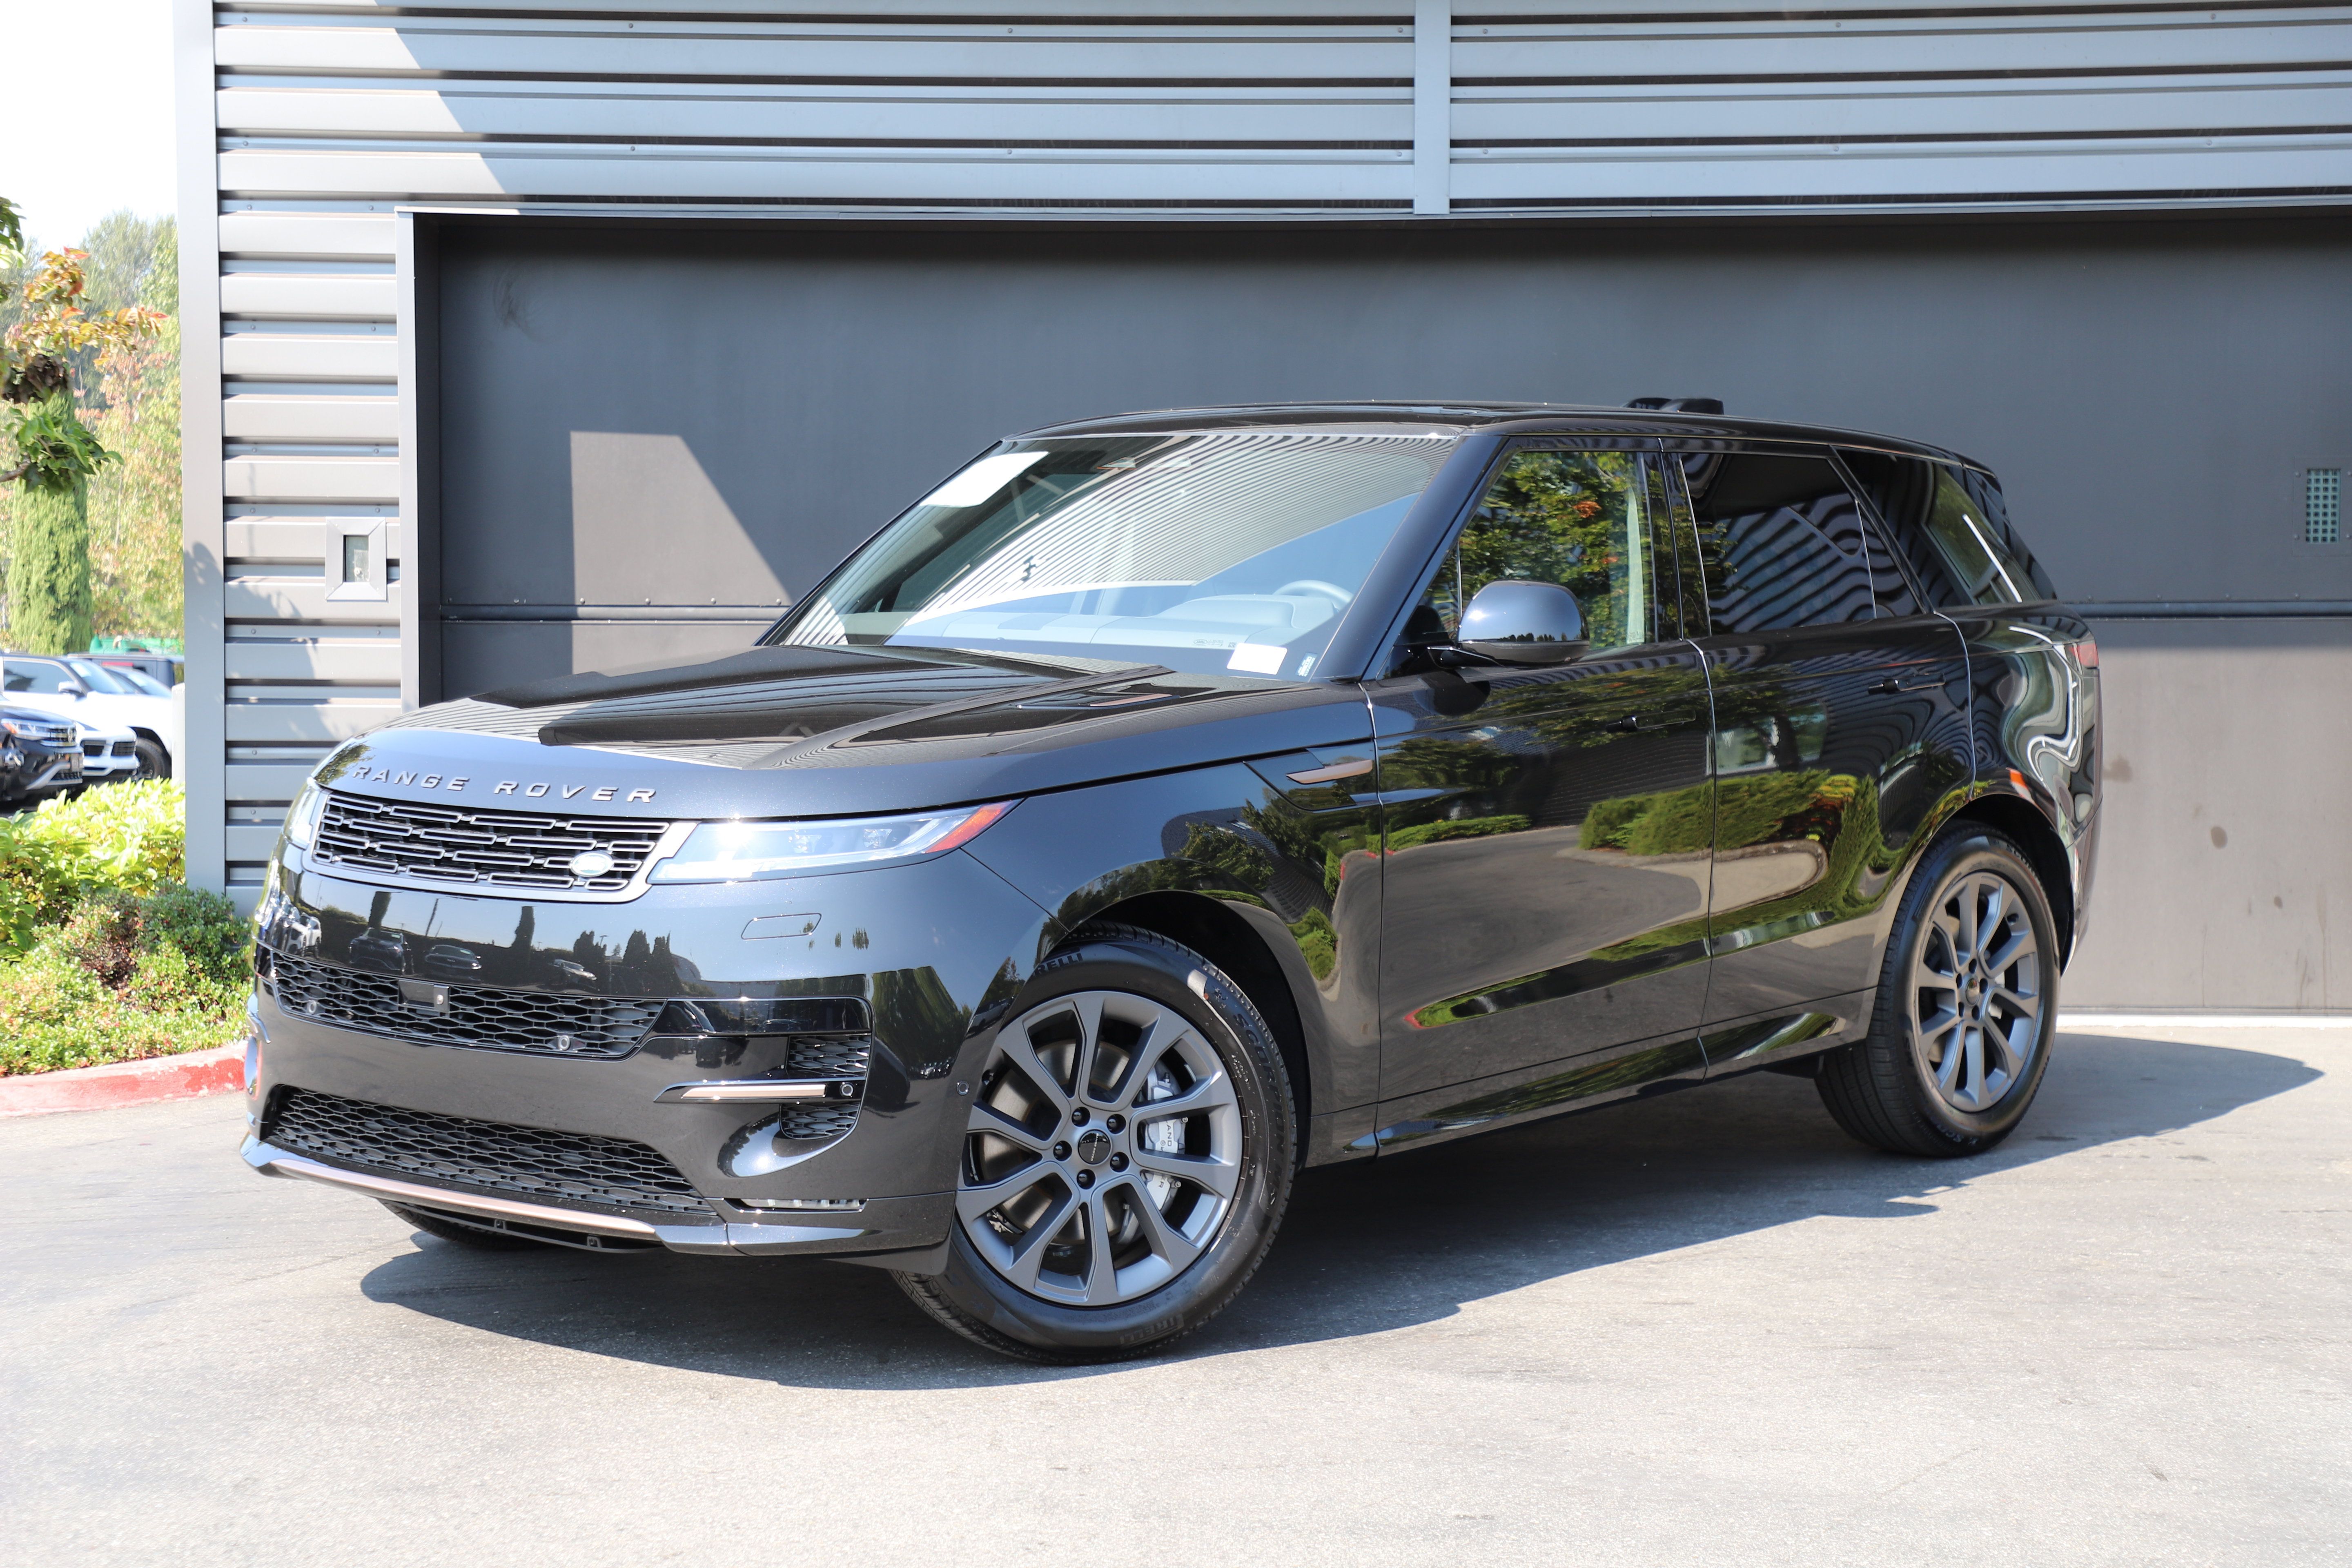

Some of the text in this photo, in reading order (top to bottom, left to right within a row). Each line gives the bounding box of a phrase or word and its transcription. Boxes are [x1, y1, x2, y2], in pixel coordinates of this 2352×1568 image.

[352, 766, 656, 804] RANGE ROVER
[1031, 950, 1083, 978] RELLI
[1233, 1012, 1285, 1154] SCORPION
